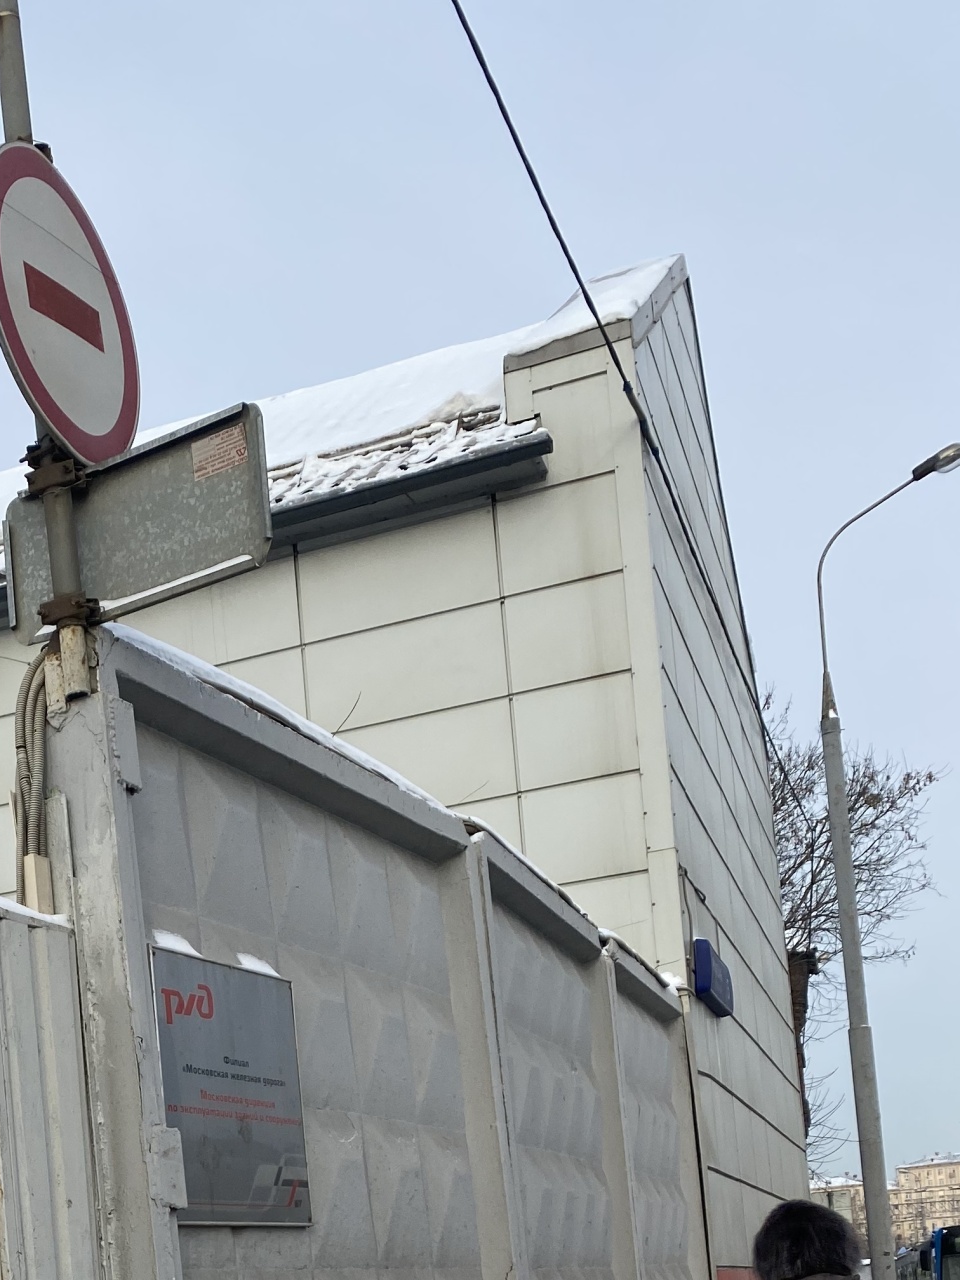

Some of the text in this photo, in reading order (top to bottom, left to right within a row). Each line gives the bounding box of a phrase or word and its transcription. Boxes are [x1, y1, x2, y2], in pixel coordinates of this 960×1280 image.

[223, 1056, 249, 1067] Филиал
[182, 1064, 286, 1088] «Московская железная дорога»
[200, 1089, 275, 1110] Московская дирекция
[167, 1104, 178, 1112] по
[180, 1105, 233, 1118] эксплуатации
[235, 1110, 259, 1121] зданий
